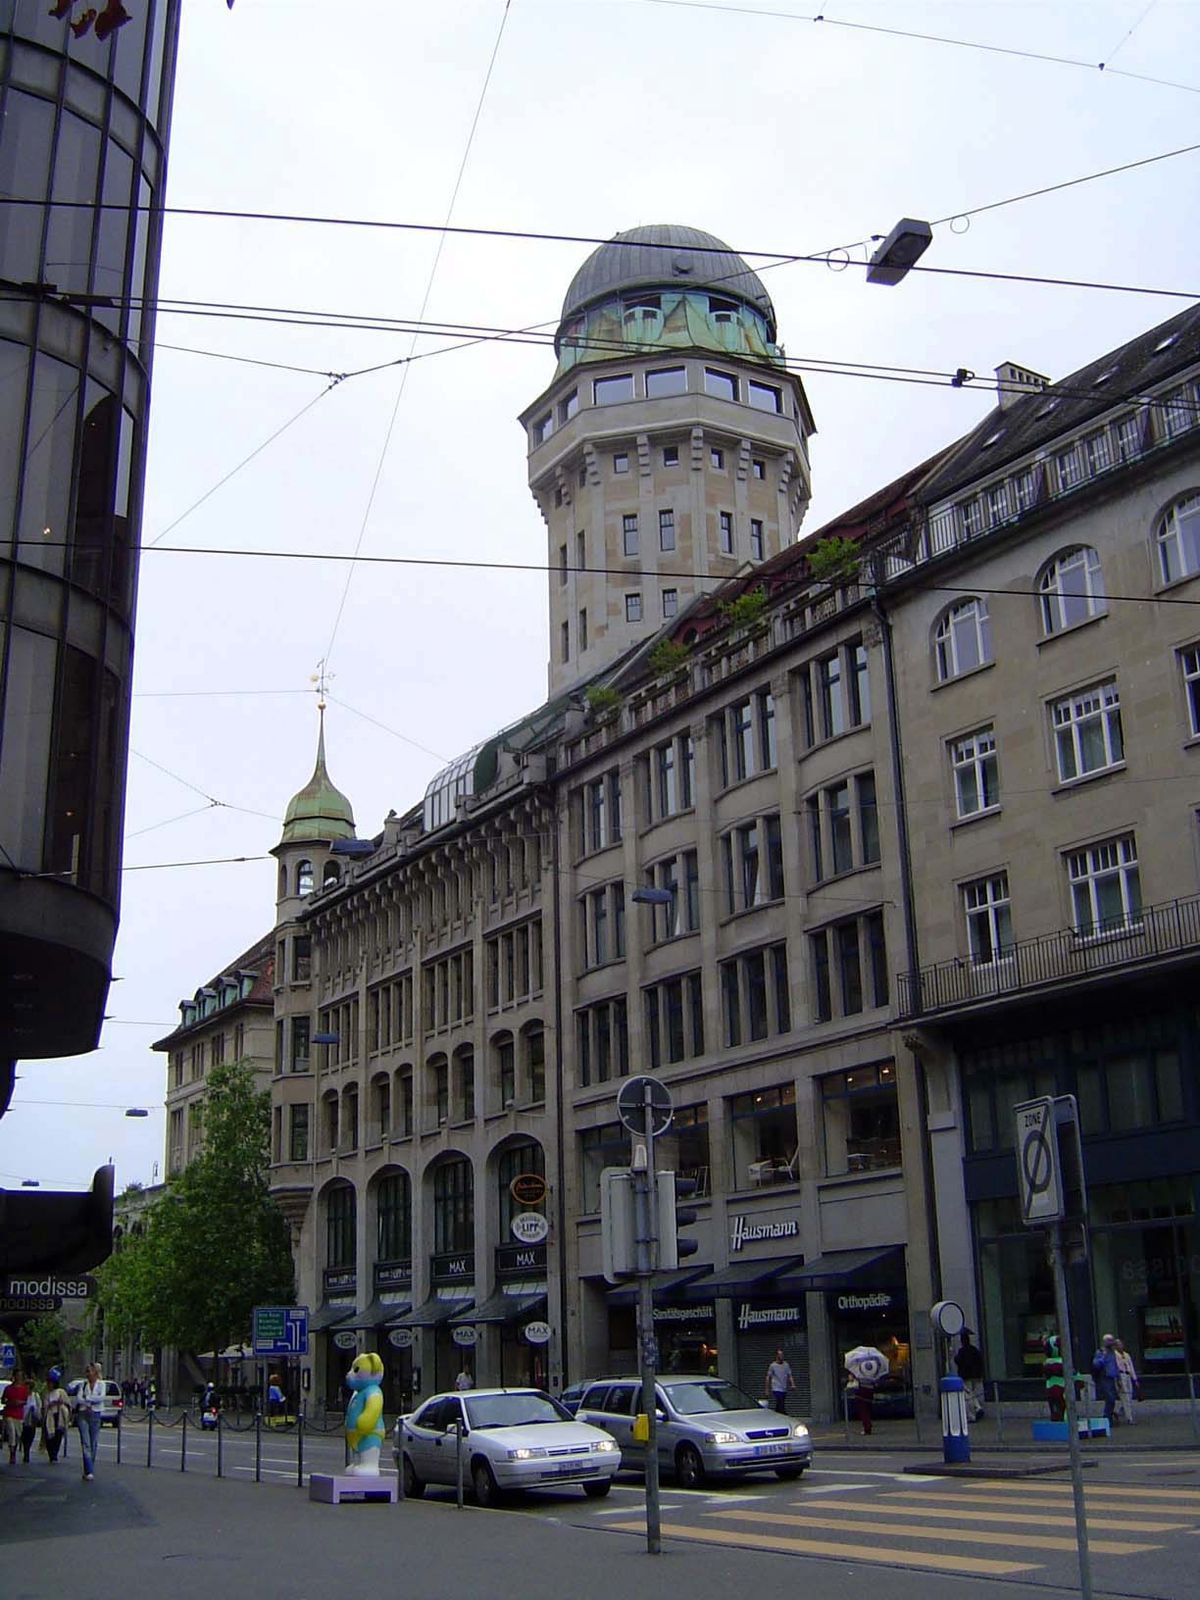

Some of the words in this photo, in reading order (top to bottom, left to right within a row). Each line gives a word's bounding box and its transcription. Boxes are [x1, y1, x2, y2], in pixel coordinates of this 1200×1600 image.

[1024, 1112, 1041, 1127] ZONE
[731, 1216, 797, 1249] Hausmann
[516, 1251, 536, 1266] MAX
[449, 1260, 466, 1273] MAX
[10, 1275, 88, 1296] modissa
[838, 1293, 890, 1310] Orthopädie
[738, 1304, 800, 1329] Hausmann
[456, 1330, 475, 1338] MAX
[527, 1325, 548, 1334] MAX
